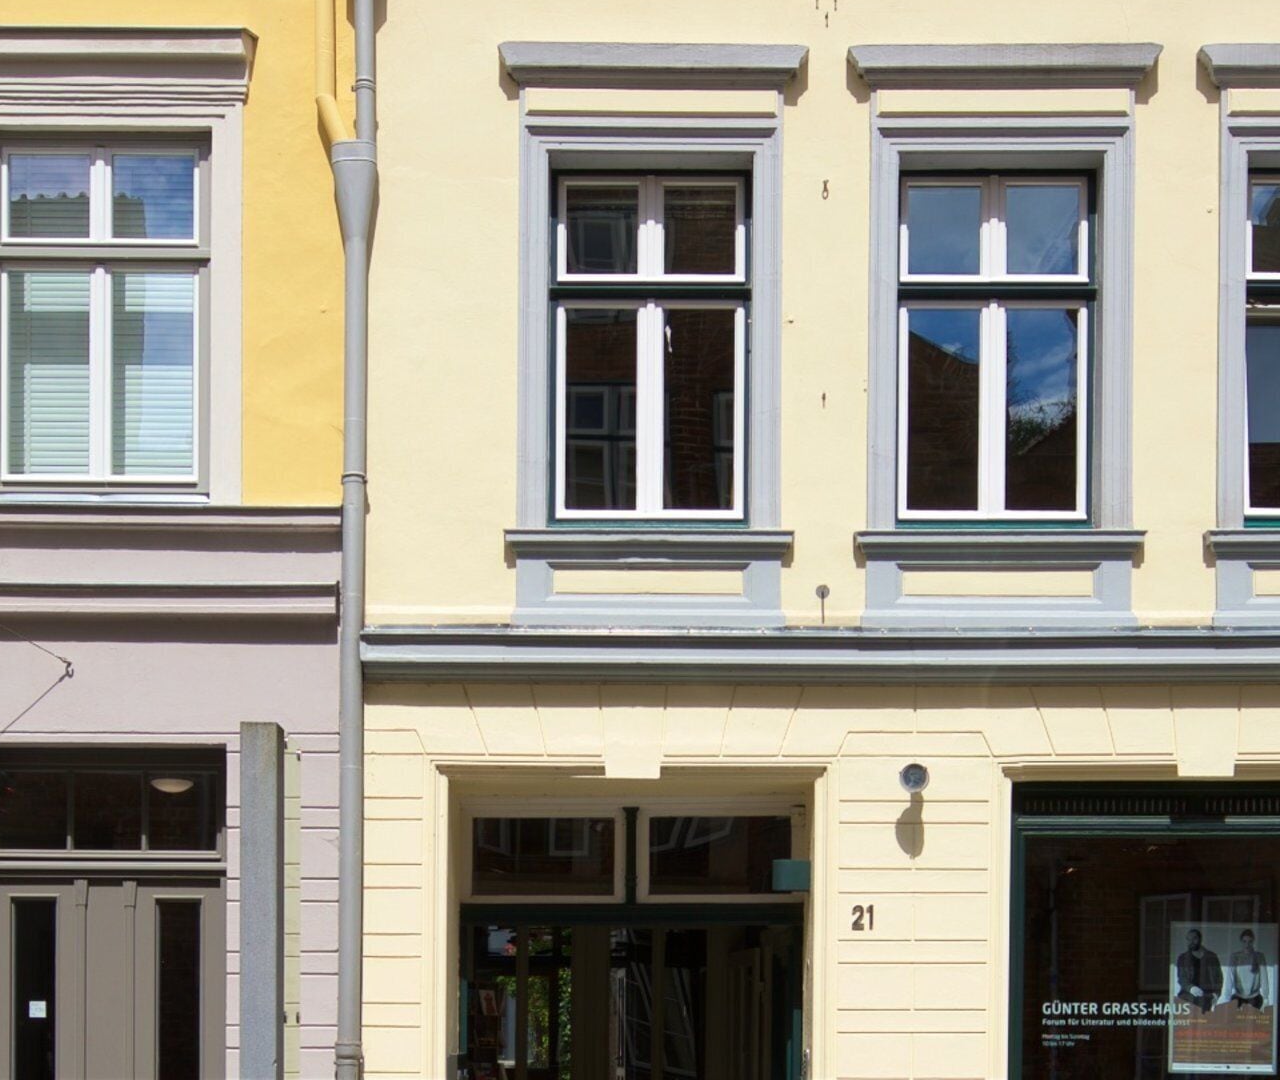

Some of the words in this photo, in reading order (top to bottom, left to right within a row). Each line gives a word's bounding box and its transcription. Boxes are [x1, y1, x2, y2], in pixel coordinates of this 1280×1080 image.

[851, 904, 874, 931] 21
[1041, 1000, 1098, 1016] GÜNTER
[1101, 1002, 1191, 1016] GRASS-HAUS
[1041, 1018, 1066, 1026] Forum
[1067, 1018, 1079, 1026] für
[1080, 1018, 1115, 1026] Literatur
[1116, 1018, 1132, 1026] und
[1132, 1018, 1166, 1026] bildende
[1168, 1018, 1191, 1026] unst
